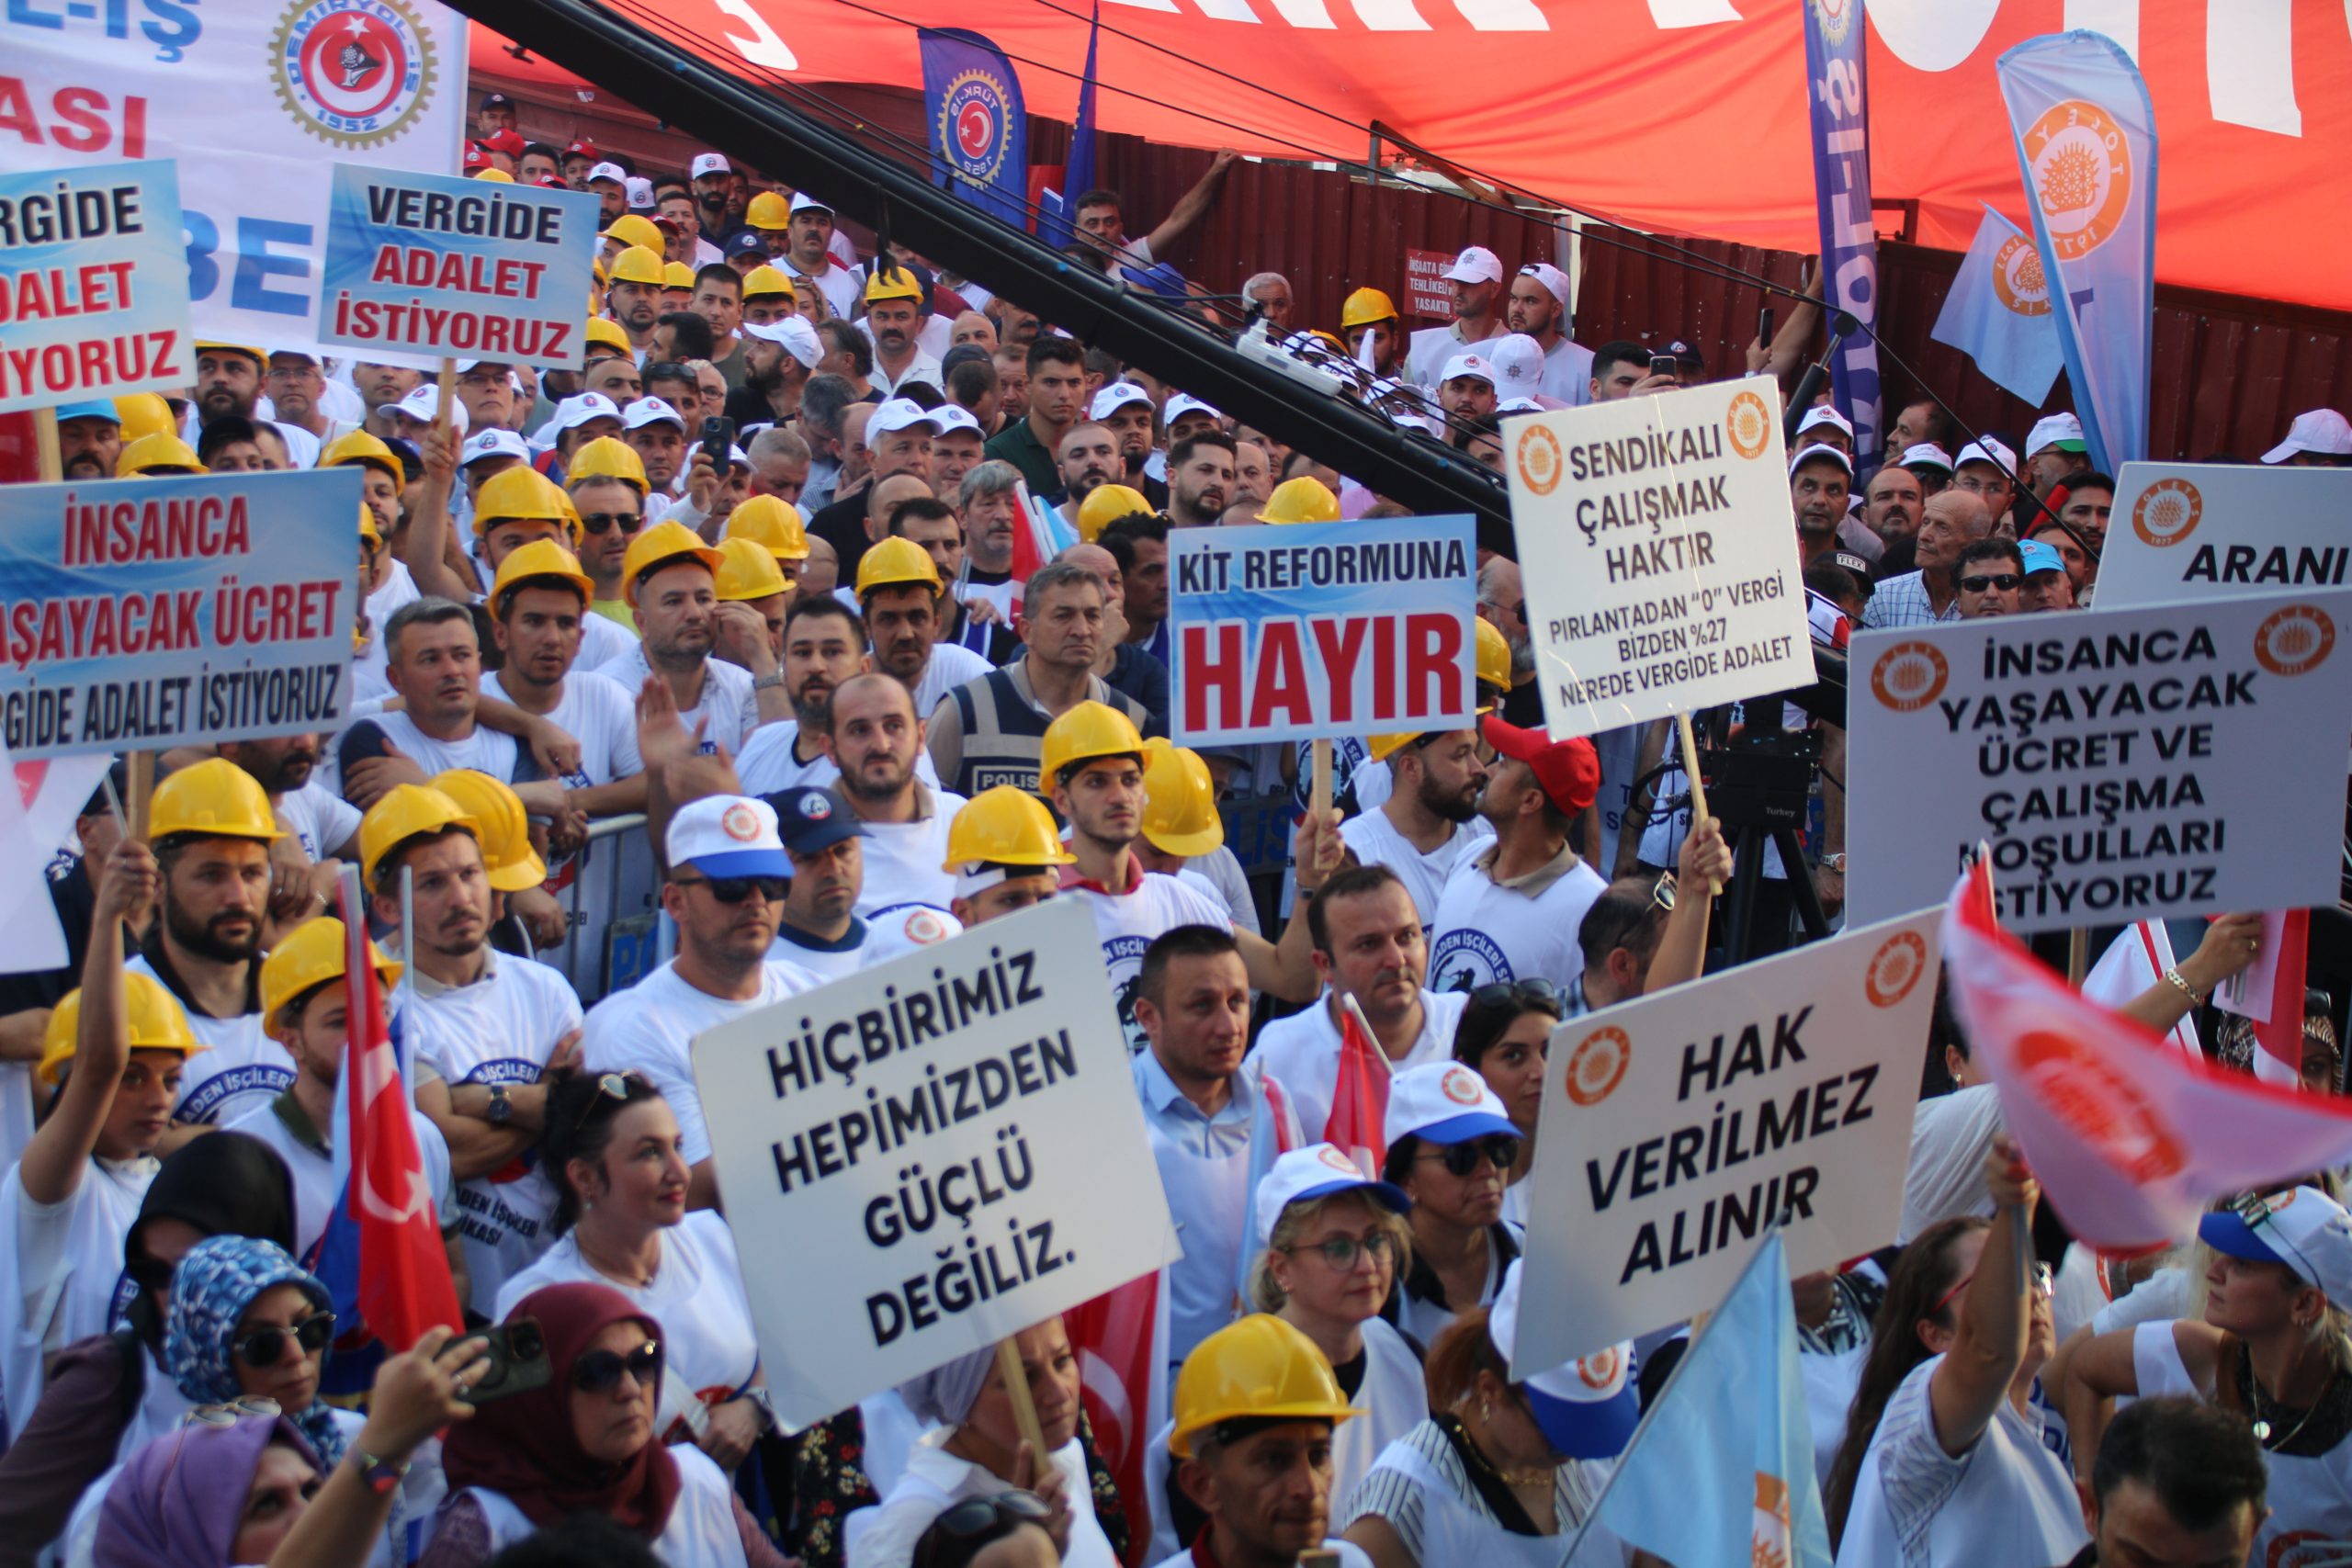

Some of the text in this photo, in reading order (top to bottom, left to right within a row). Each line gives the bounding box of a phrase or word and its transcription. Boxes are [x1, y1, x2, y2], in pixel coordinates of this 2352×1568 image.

[317, 109, 379, 132] 1952
[368, 186, 563, 244] VERGİDE
[371, 246, 548, 299] ADALET
[1410, 277, 1448, 295] TEHLİKELİ
[1415, 297, 1450, 314] YASAKTIR
[335, 291, 572, 359] İSTİYORUZ
[1570, 424, 1723, 481] SENDİKALI
[63, 492, 251, 566] İNSANCA
[1576, 475, 1732, 547] ÇALIŞMAK
[1179, 539, 1467, 593] KİT REFORMUNA
[1606, 531, 1715, 584] HAKTIR
[2181, 545, 2350, 585] ARANI
[214, 576, 342, 647] ÜCRET
[1550, 595, 1689, 644] PIRLANTADAN
[1727, 569, 1785, 606] VERGİ
[1618, 617, 1727, 662] BİZDEN %27
[1183, 613, 1463, 733] HAYIR
[1560, 636, 1792, 707] NEREDE VERGİDE ADALET
[1984, 627, 2217, 681] İNSANCA
[0, 659, 342, 750] GİDE ADALET İSTİYORUZ
[1939, 670, 2258, 739] YAŞAYACAK
[1978, 723, 2214, 777] ÜCRET VE
[1765, 807, 1796, 818] Turkey
[1981, 773, 2205, 837] ÇALIŞMA
[766, 946, 1045, 1100] HİÇBİRİMİZ
[1677, 1004, 1815, 1102] HAK
[771, 1028, 1080, 1194] HEPİMİZDEN
[1586, 1064, 1881, 1213] VERİLMEZ
[864, 1123, 1034, 1247] GÜÇLÜ
[1620, 1166, 1819, 1285] ALINIR
[865, 1217, 1077, 1348] DEĞİLİZ.
